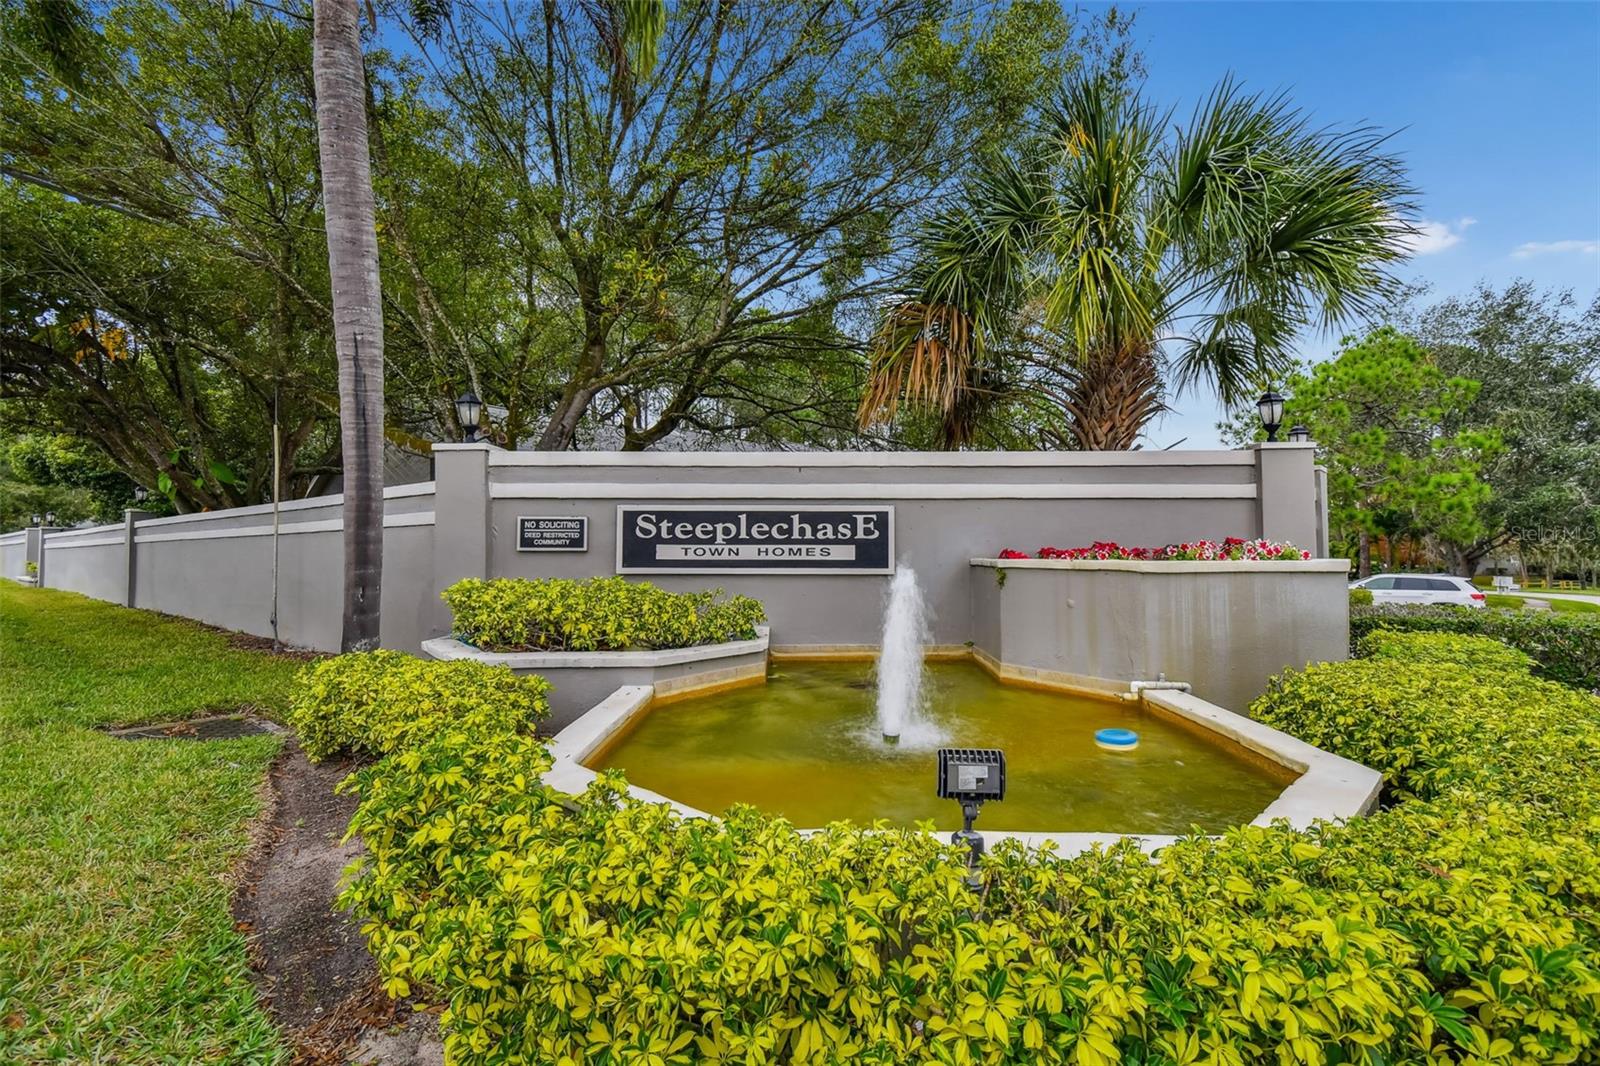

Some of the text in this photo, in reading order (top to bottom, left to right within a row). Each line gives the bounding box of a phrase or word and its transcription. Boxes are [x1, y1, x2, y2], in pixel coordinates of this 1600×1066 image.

[524, 521, 580, 529] NO SOLICITING
[635, 513, 880, 544] SteeplechasE
[681, 547, 832, 557] TOWN HOMES
